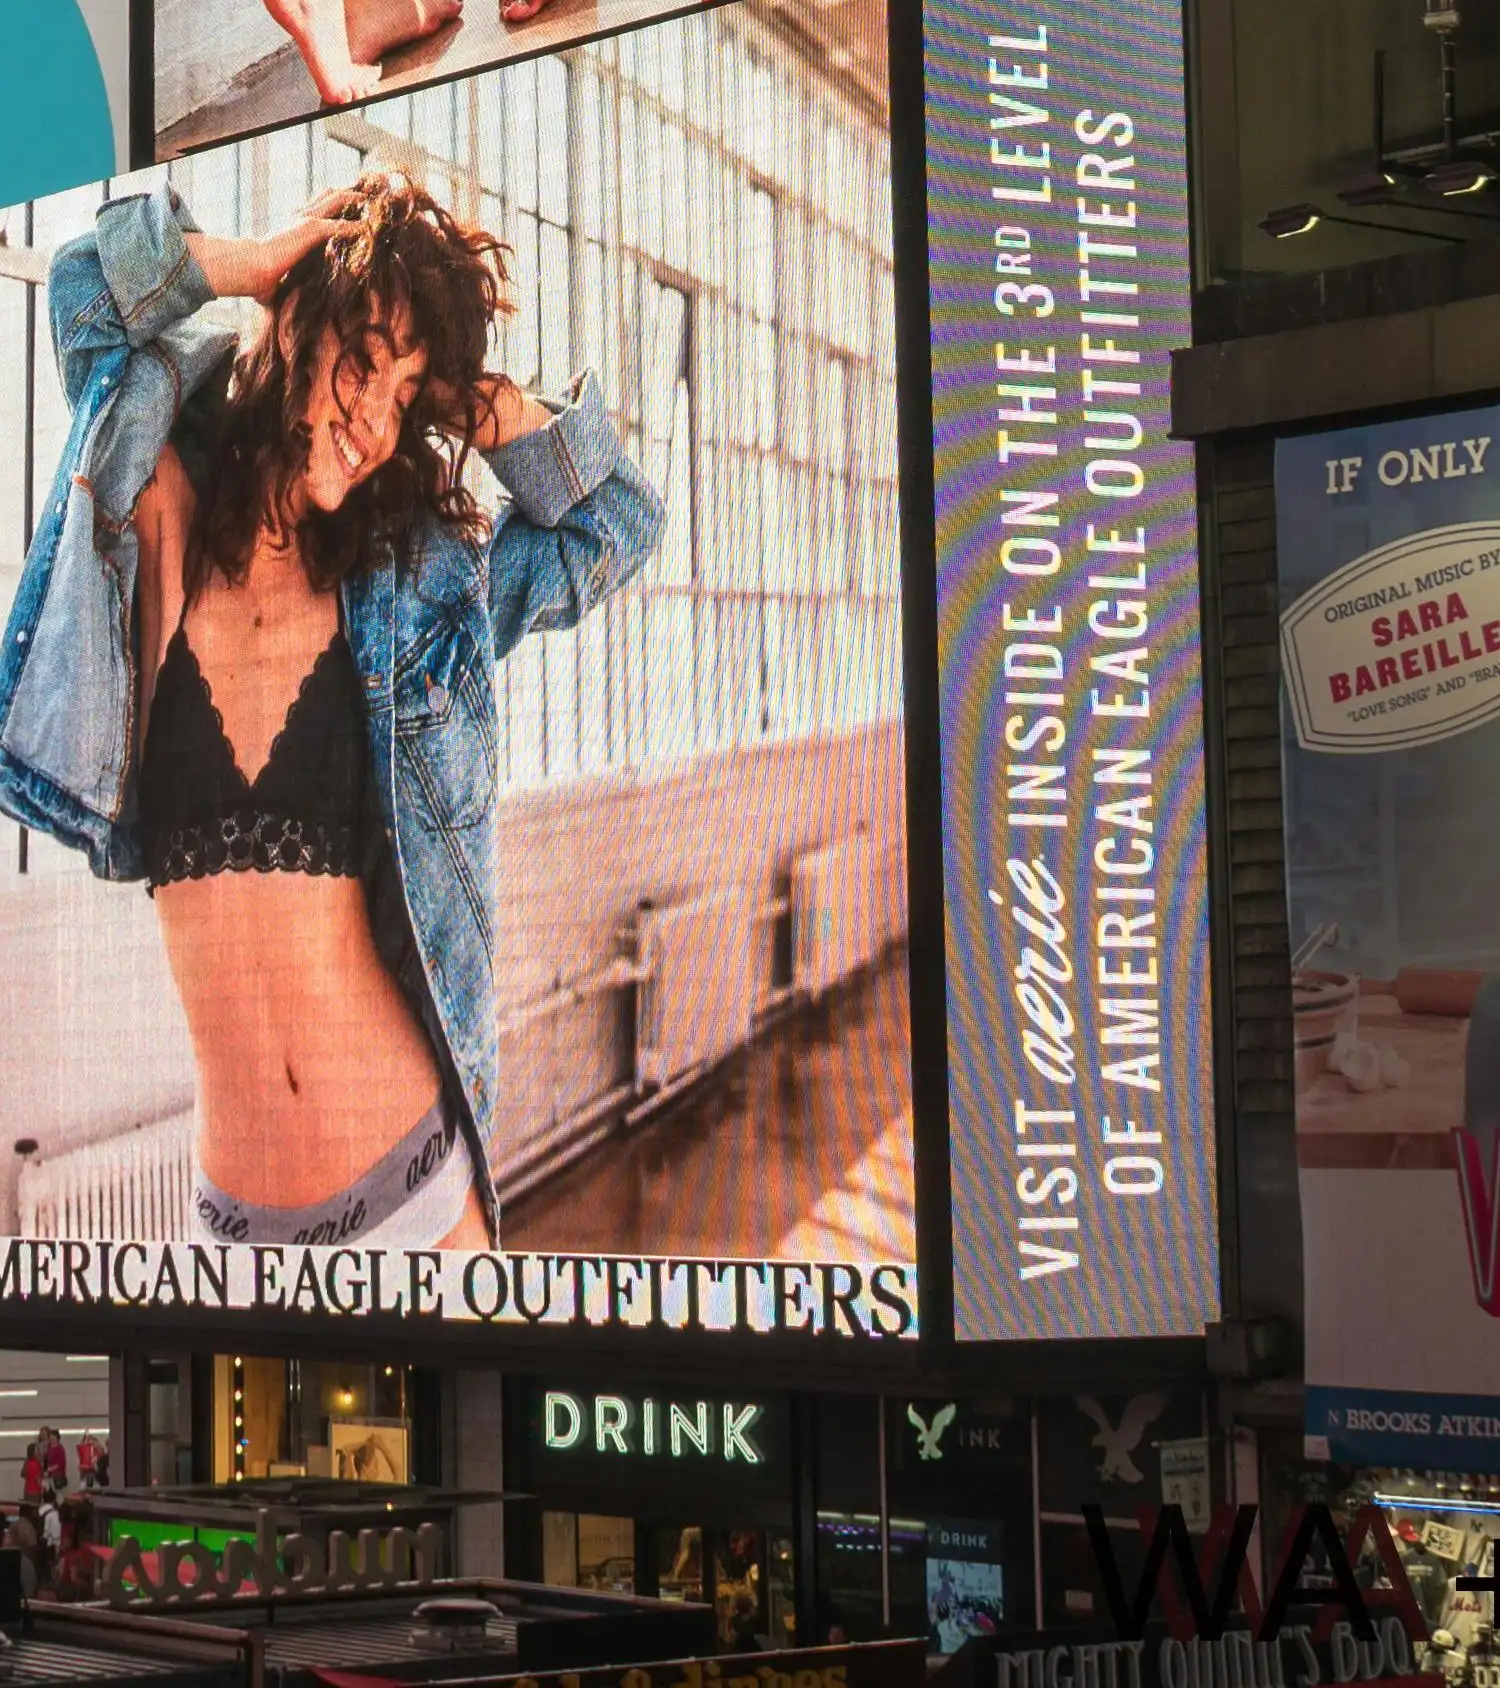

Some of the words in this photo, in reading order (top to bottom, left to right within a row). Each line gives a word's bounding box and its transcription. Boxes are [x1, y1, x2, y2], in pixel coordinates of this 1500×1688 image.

[987, 24, 1052, 204] LEVEL
[995, 225, 1055, 319] 3RD
[1074, 108, 1146, 498] OUTFITTERS
[996, 342, 1059, 463] THE
[1326, 458, 1363, 496] IF
[1377, 436, 1491, 487] ONLY
[998, 489, 1062, 575] ON
[1087, 525, 1151, 719] EAGLE
[1324, 583, 1412, 624] ORIGINAL
[1415, 559, 1475, 593] MUSIC
[1371, 592, 1469, 647] SARA
[1001, 602, 1068, 829] INSIDE
[1436, 676, 1466, 697] AND
[1092, 748, 1162, 1092] AMERICAN
[987, 853, 1076, 1086] aerie
[1014, 1099, 1082, 1281] VISIT
[1103, 1116, 1165, 1197] OF
[250, 1248, 444, 1316] EAGLE
[461, 1253, 915, 1338] OUTFITTERS
[545, 1391, 761, 1463] DRINK
[1346, 1409, 1431, 1435] BROOKS
[940, 1532, 988, 1549] DRINK
